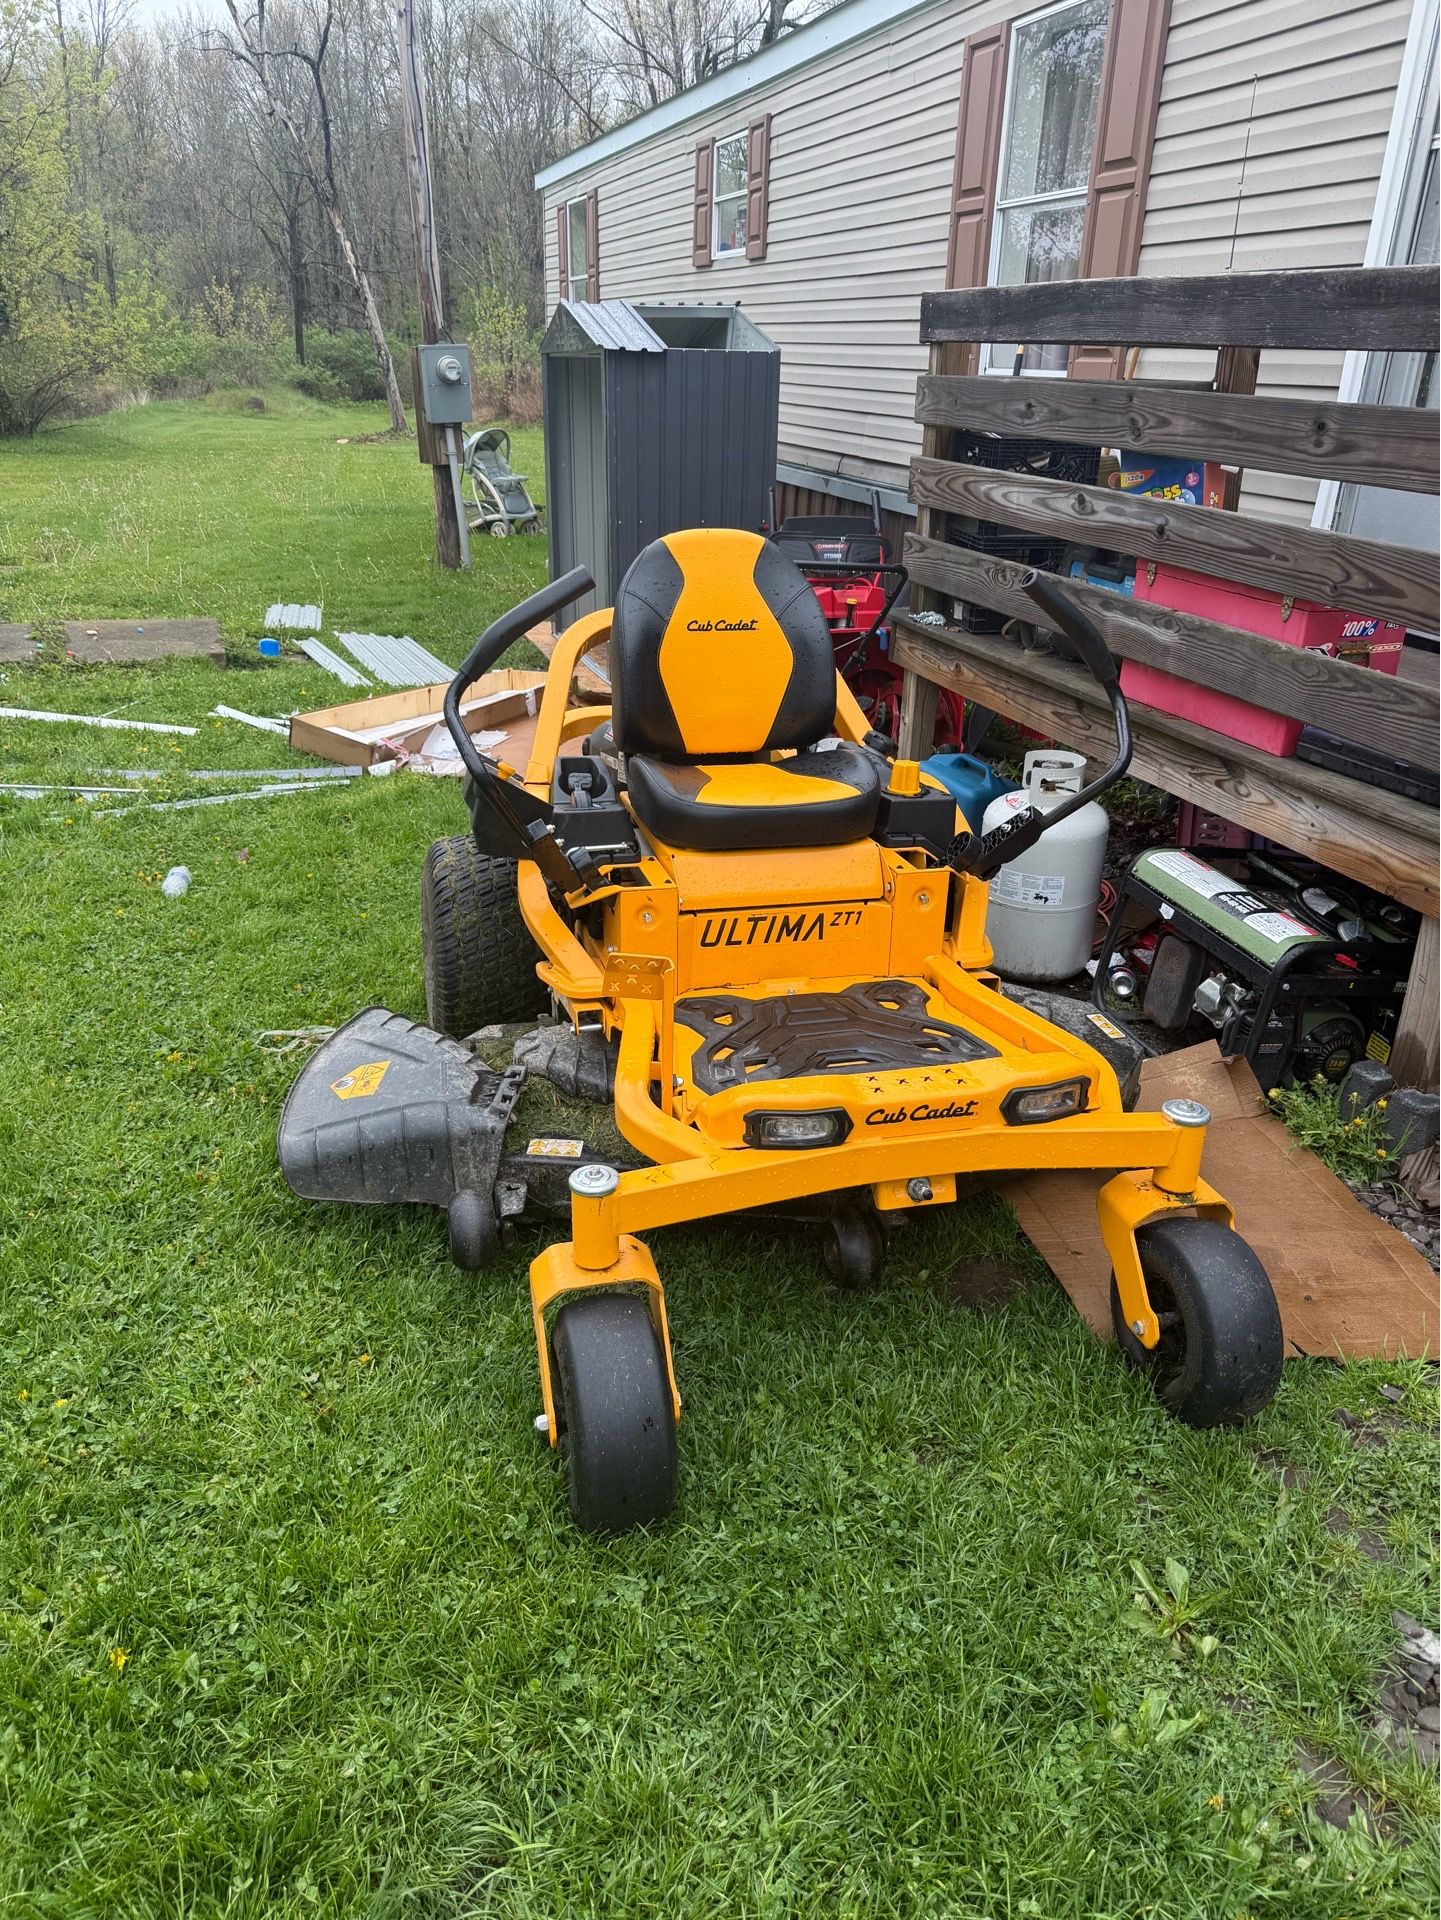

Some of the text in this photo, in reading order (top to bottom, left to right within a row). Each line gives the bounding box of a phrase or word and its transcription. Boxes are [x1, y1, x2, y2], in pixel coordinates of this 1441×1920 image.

[686, 619, 759, 632] Cub Cadet
[1341, 620, 1377, 637] 100%
[700, 910, 863, 948] ULTIMA ZT1
[865, 1100, 979, 1126] Cub Cadet
